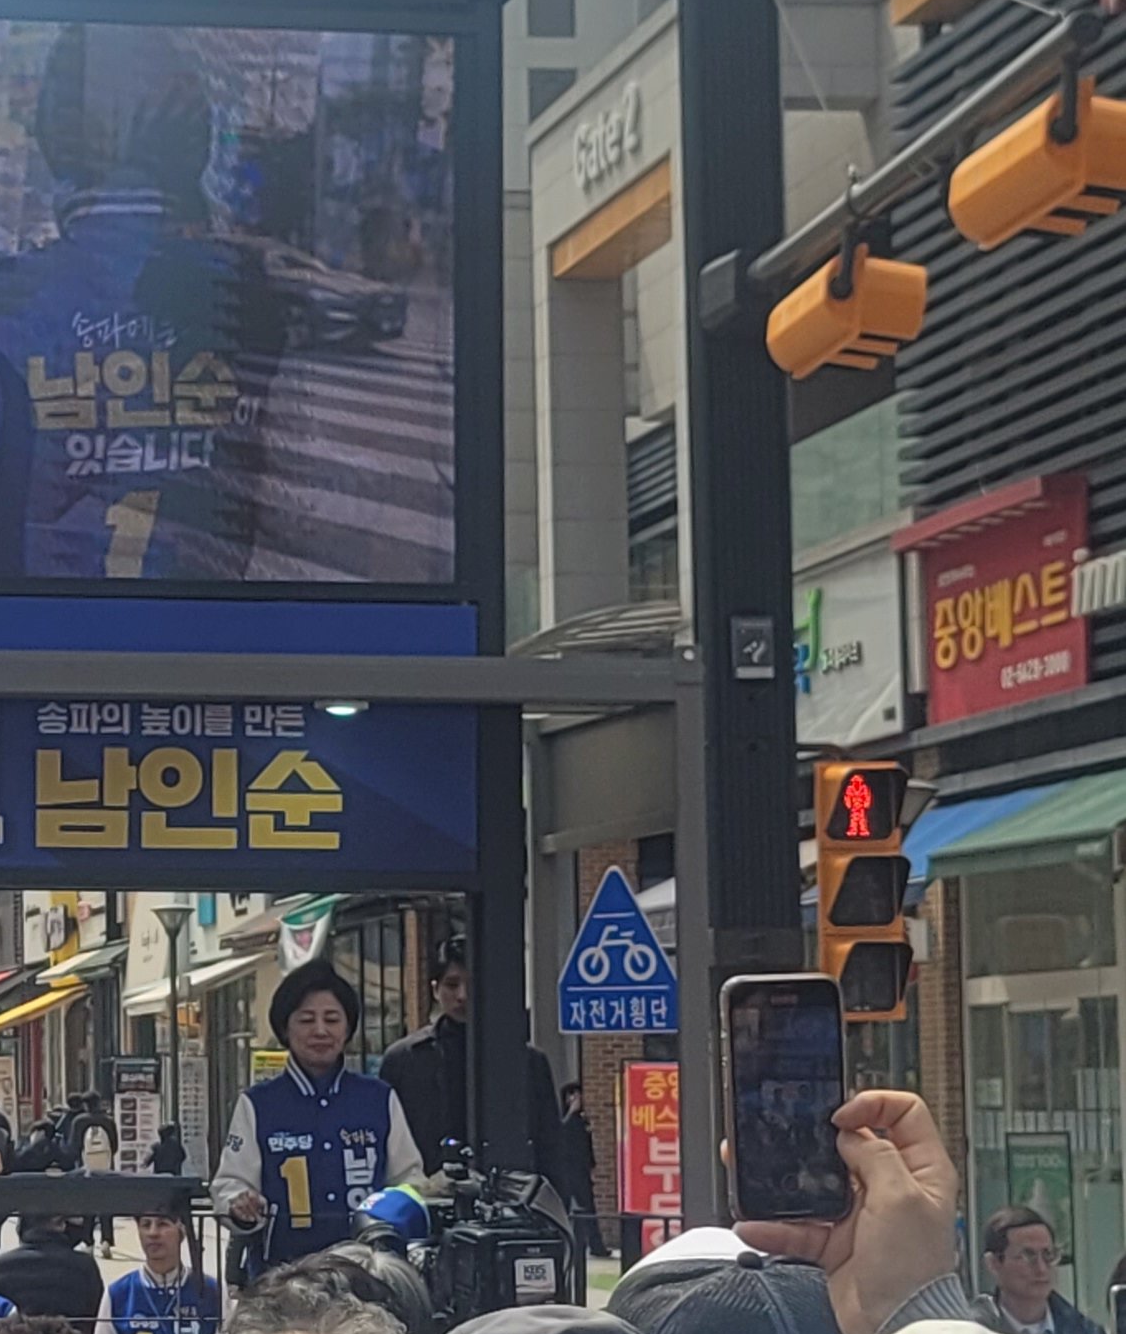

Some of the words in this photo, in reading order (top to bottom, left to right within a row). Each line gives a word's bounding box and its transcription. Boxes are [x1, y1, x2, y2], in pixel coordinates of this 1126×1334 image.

[573, 111, 622, 188] Gate
[622, 80, 640, 151] 2
[66, 432, 216, 477] 있습니다
[104, 489, 160, 579] 1
[933, 560, 1071, 670] 중앙베스트
[36, 700, 131, 736] 송파의
[140, 702, 234, 737] 높이를
[243, 704, 305, 738] 만든
[34, 746, 344, 850] 남인순
[569, 995, 668, 1030] 자전거횡단
[267, 1133, 314, 1154] 민주당
[279, 1155, 313, 1229] 1
